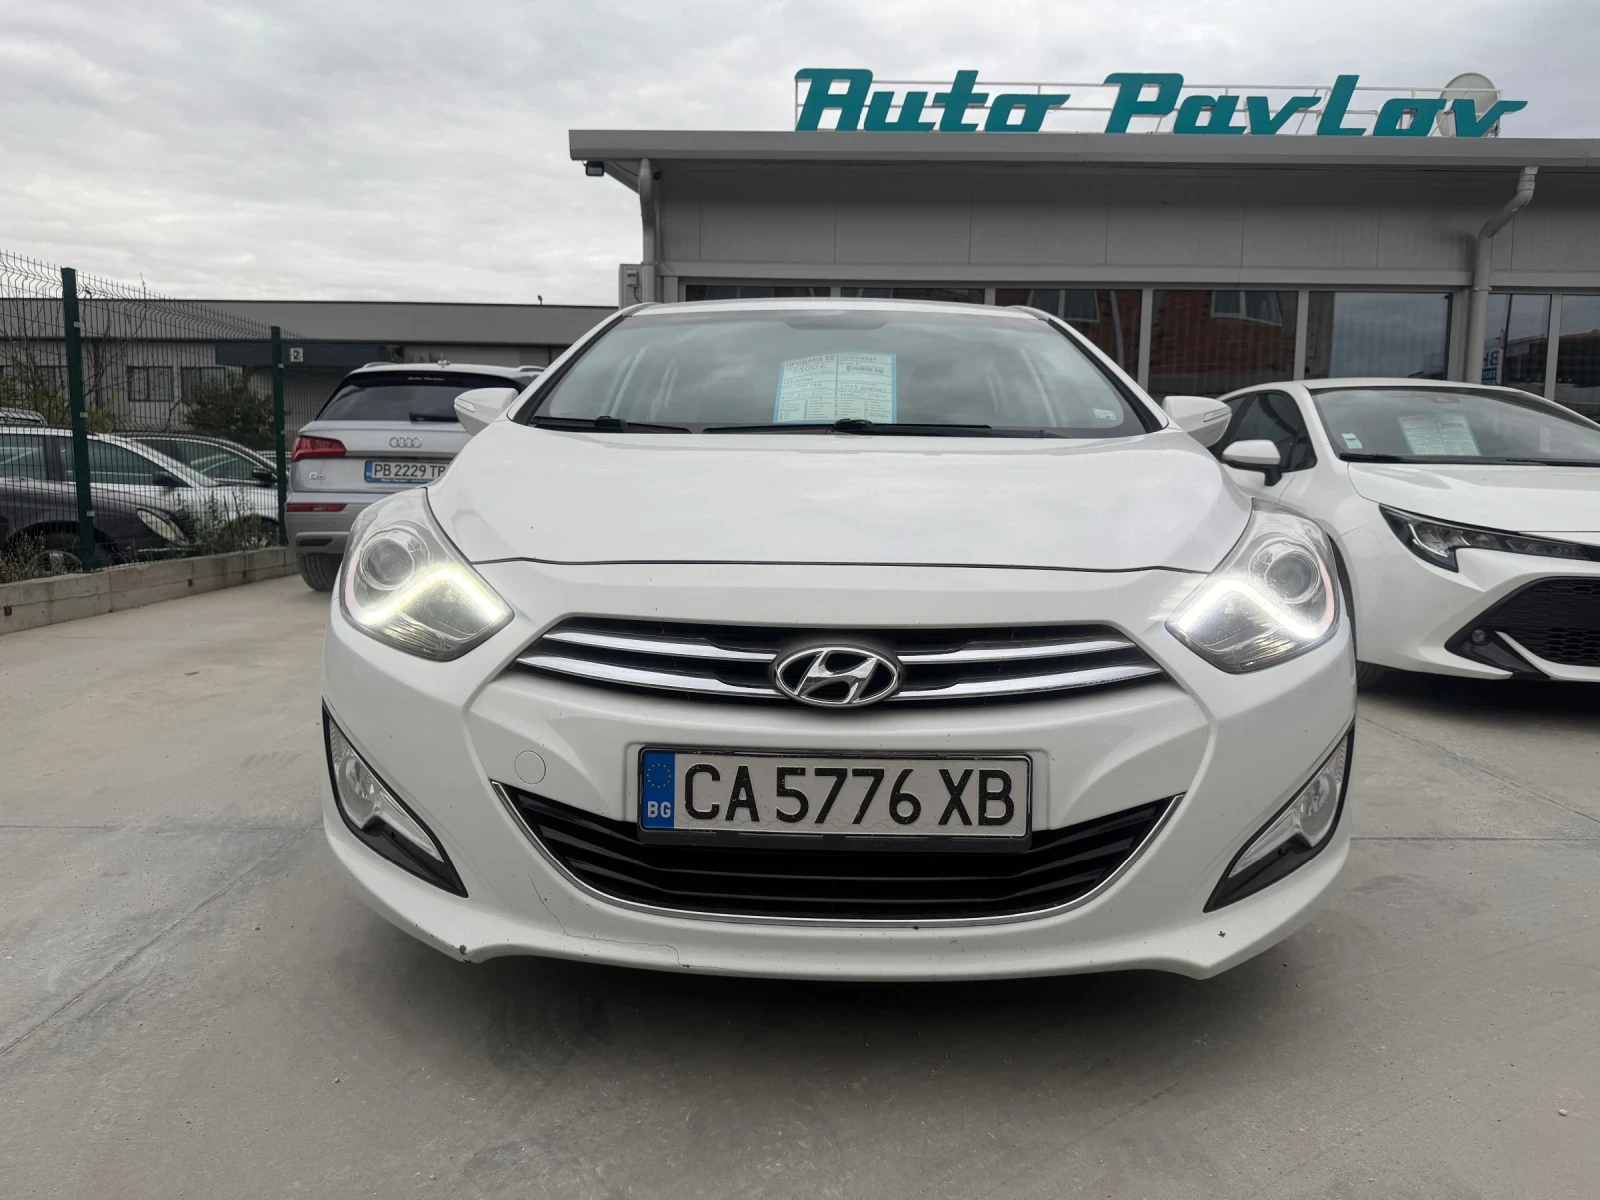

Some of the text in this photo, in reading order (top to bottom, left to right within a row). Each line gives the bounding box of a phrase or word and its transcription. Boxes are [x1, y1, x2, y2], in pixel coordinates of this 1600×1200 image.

[795, 68, 1071, 132] Auto
[374, 463, 392, 477] PB
[394, 464, 427, 478] 2229
[646, 800, 672, 818] BG
[684, 764, 1014, 826] CA 5776 XB
